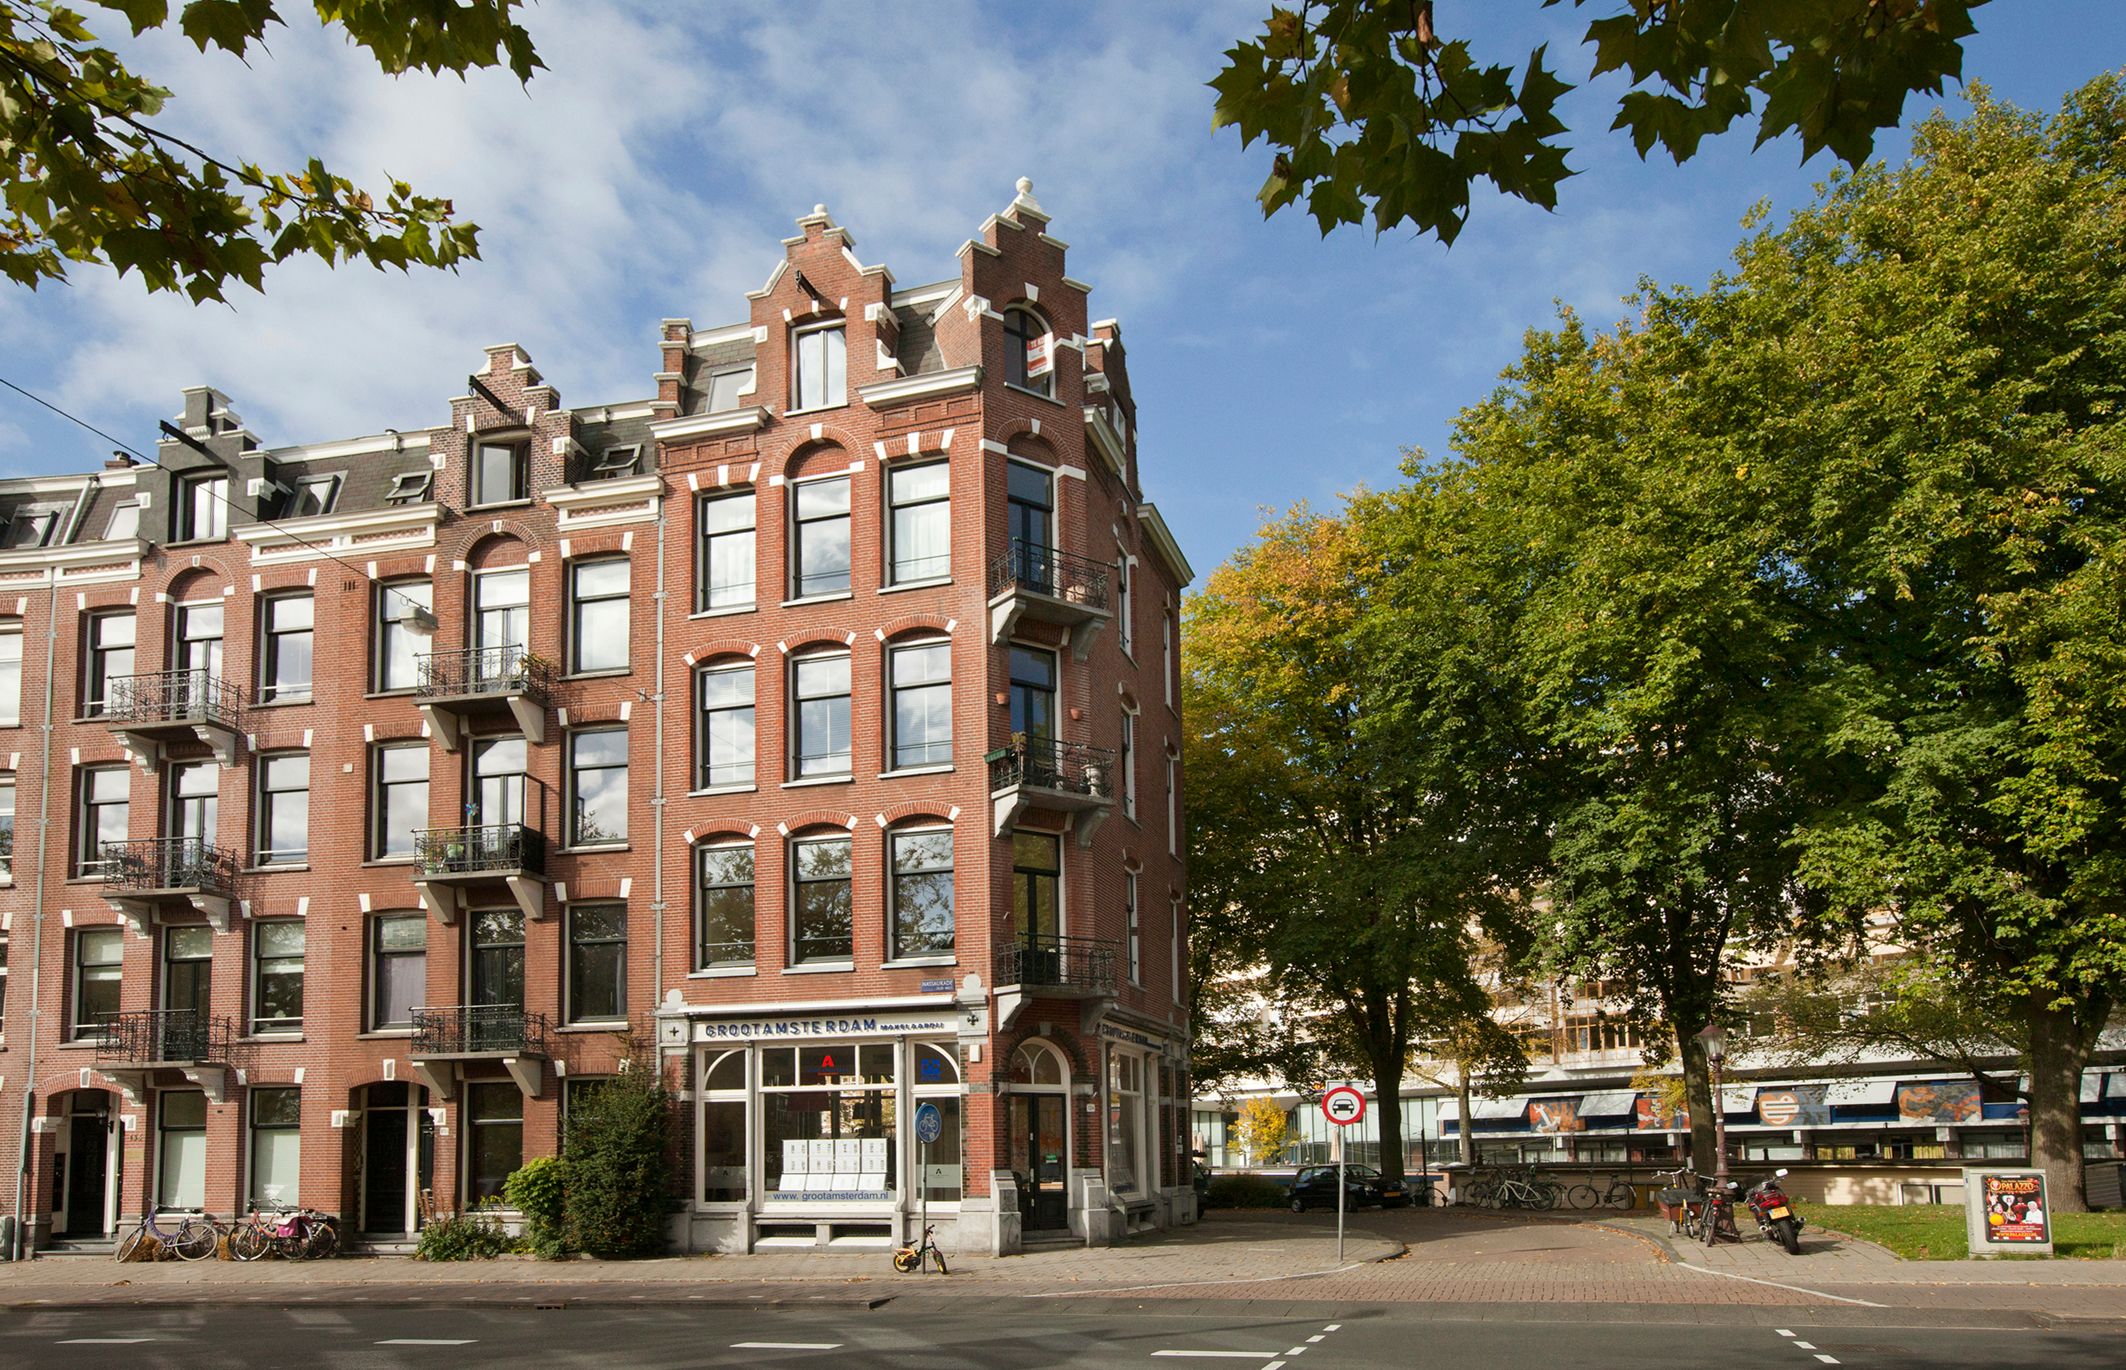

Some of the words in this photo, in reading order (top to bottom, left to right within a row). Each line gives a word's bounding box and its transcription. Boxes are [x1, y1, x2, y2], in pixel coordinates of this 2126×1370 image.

[705, 1018, 877, 1037] GROOTAMSTERDAM
[822, 1055, 834, 1067] A
[2001, 1182, 2035, 1191] PALAZZO
[773, 1192, 798, 1200] www.
[801, 1191, 889, 1202] grootamsterdam.nl
